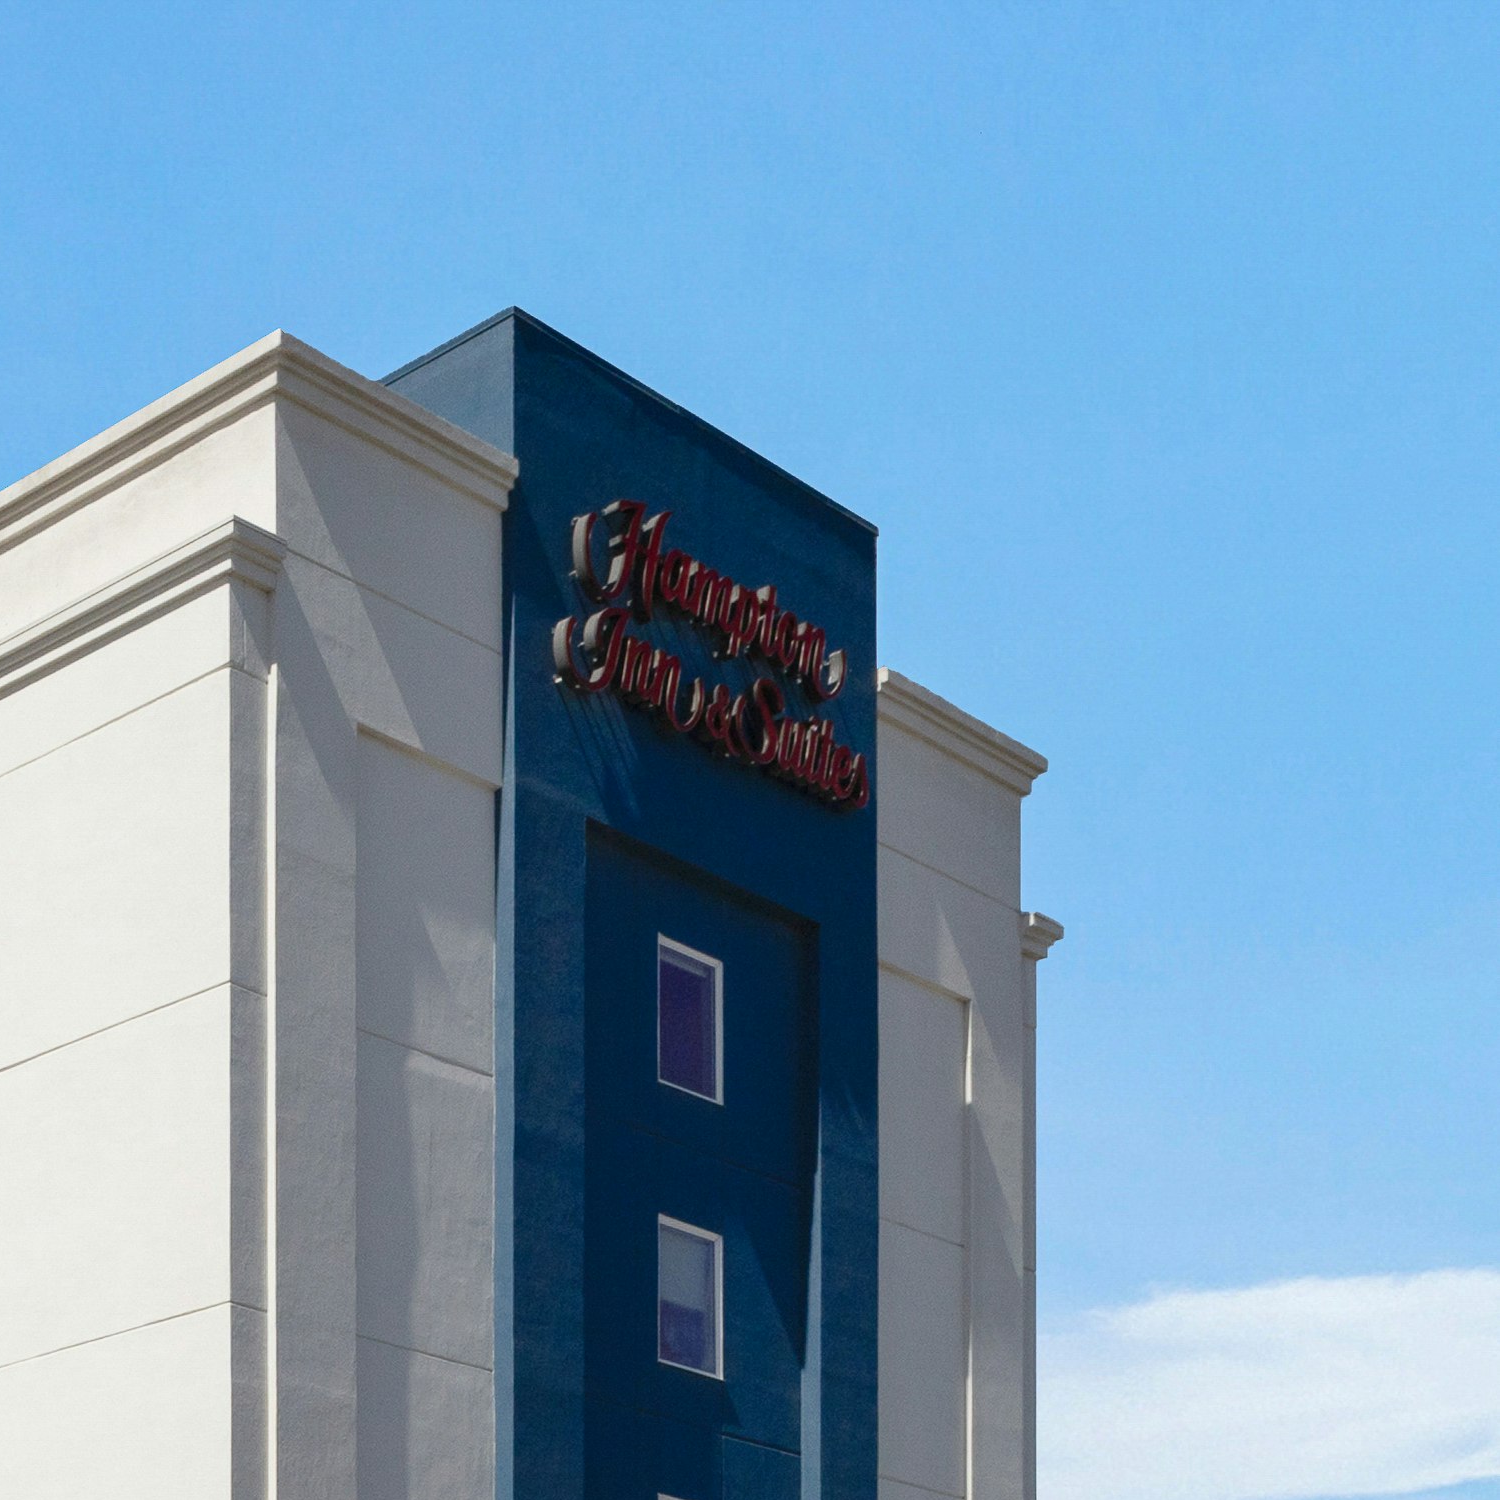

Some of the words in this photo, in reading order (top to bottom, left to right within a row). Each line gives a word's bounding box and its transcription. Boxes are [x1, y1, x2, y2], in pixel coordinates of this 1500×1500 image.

[571, 500, 848, 699] Hampton
[553, 608, 704, 732] Inn
[733, 678, 869, 808] Suites
